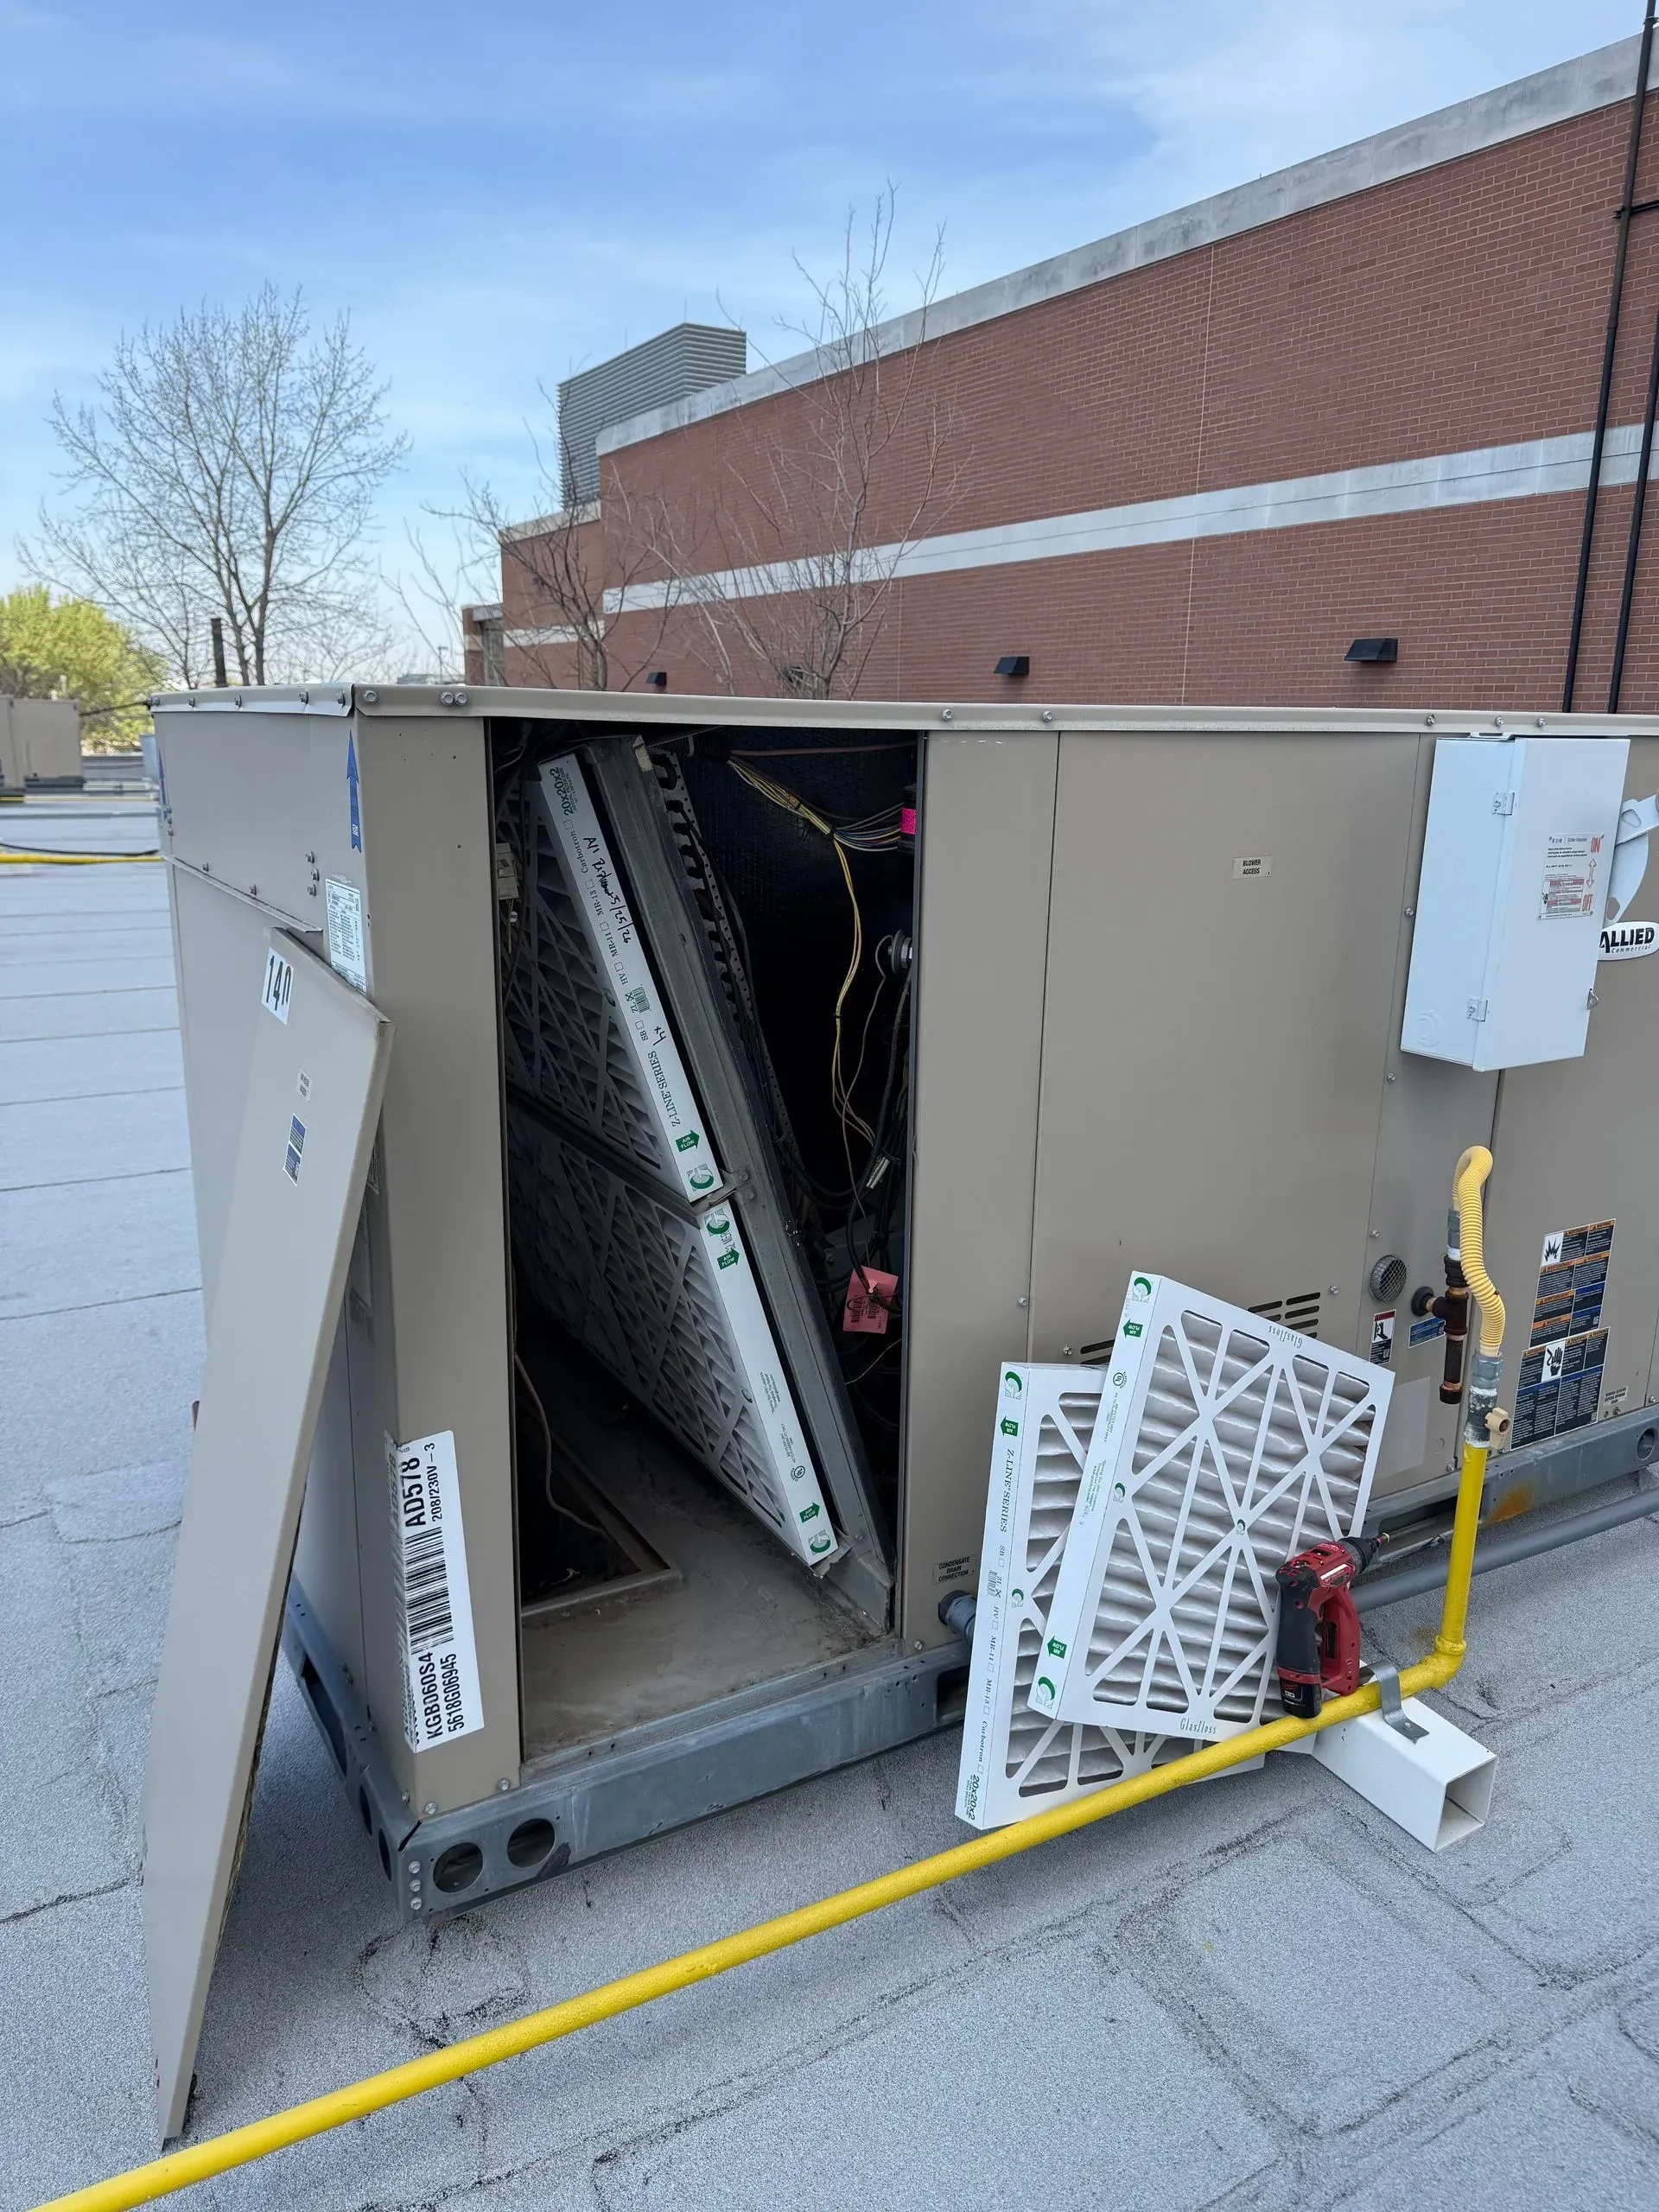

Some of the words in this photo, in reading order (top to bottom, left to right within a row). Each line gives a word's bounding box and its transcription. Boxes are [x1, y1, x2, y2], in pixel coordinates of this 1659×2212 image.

[548, 766, 574, 816] 20x20x2
[570, 830, 588, 874] Carbotron
[1591, 837, 1601, 853] ON
[589, 889, 603, 917] MR-13
[1582, 893, 1593, 911] OFF
[604, 931, 619, 957] MR-11
[1599, 926, 1655, 953] ALLIED
[1611, 944, 1652, 955] Commercial
[620, 972, 628, 985] HV
[631, 1002, 638, 1014] ZL
[640, 1029, 648, 1041] SB
[647, 1051, 668, 1089] SERIES
[680, 1139, 695, 1150] FLOW
[681, 1135, 691, 1144] AIR
[1268, 1324, 1303, 1349] Glasfloss
[403, 1458, 426, 1528] AD578
[1000, 1491, 1010, 1533] SERIES
[999, 1545, 1006, 1557] SB
[938, 1556, 969, 1569] CONDENSATE
[947, 1565, 962, 1573] DRAIN
[938, 1569, 969, 1582] CONNECTION
[993, 1606, 1000, 1619] HV
[417, 1652, 443, 1740] KGB060S4
[442, 1652, 465, 1739] 5618G06945
[983, 1677, 992, 1705] MR-13
[1179, 1717, 1217, 1736] Glasfloss
[978, 1720, 988, 1763] Carbotron
[968, 1774, 980, 1820] 20x20x2
